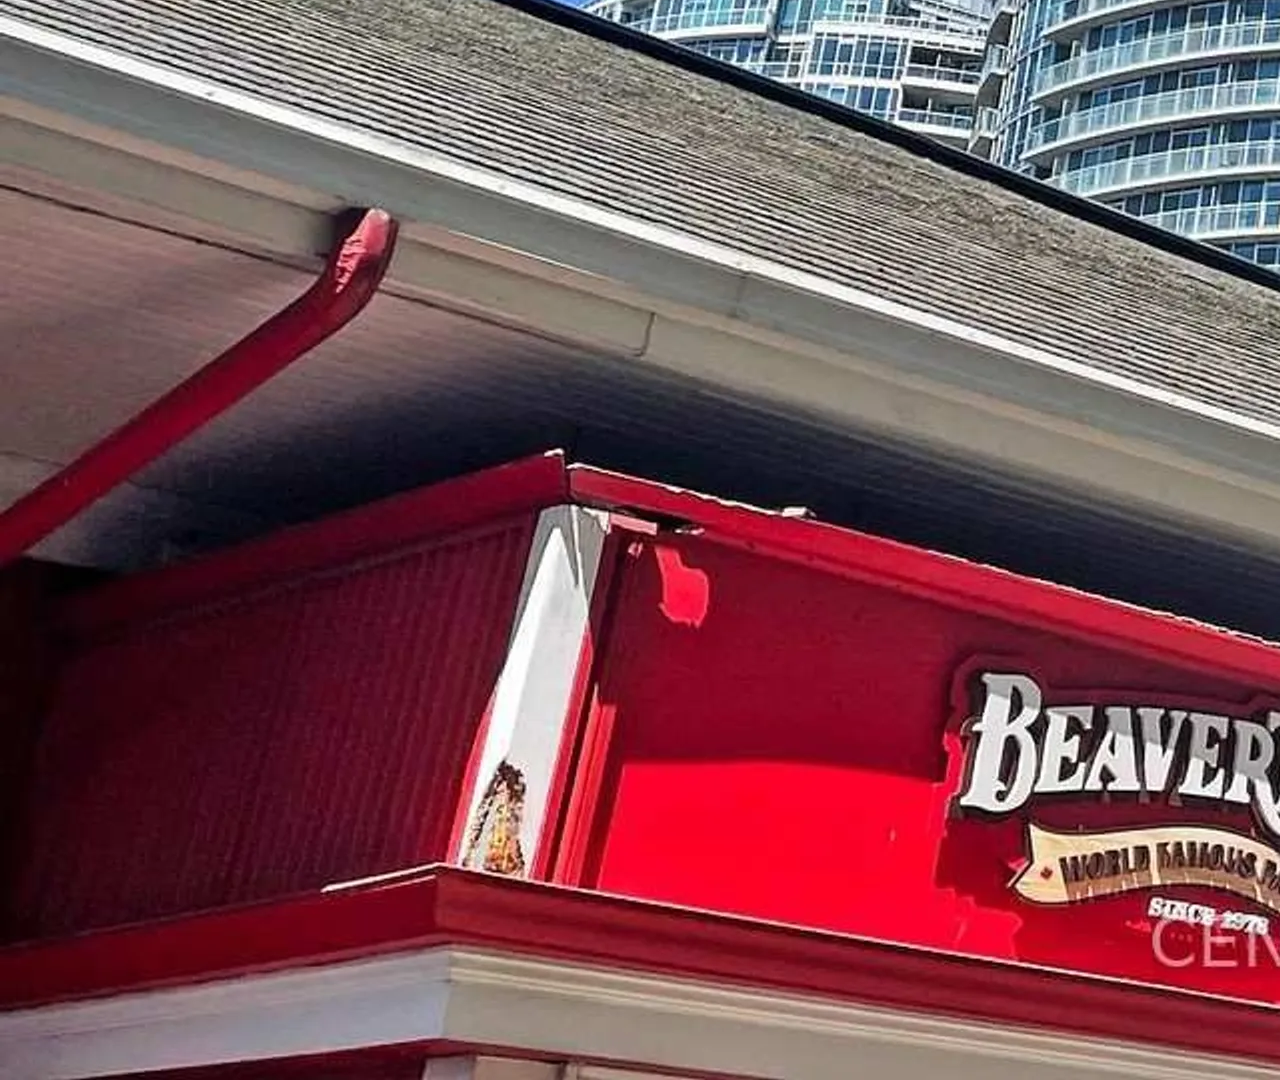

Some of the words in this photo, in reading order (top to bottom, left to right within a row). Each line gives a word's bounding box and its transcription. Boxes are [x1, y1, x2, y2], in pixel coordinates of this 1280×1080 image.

[1058, 843, 1149, 883] WORLD
[1156, 840, 1257, 879] FAMOUS
[1147, 896, 1216, 927] SINCE
[1220, 909, 1269, 936] 1978
